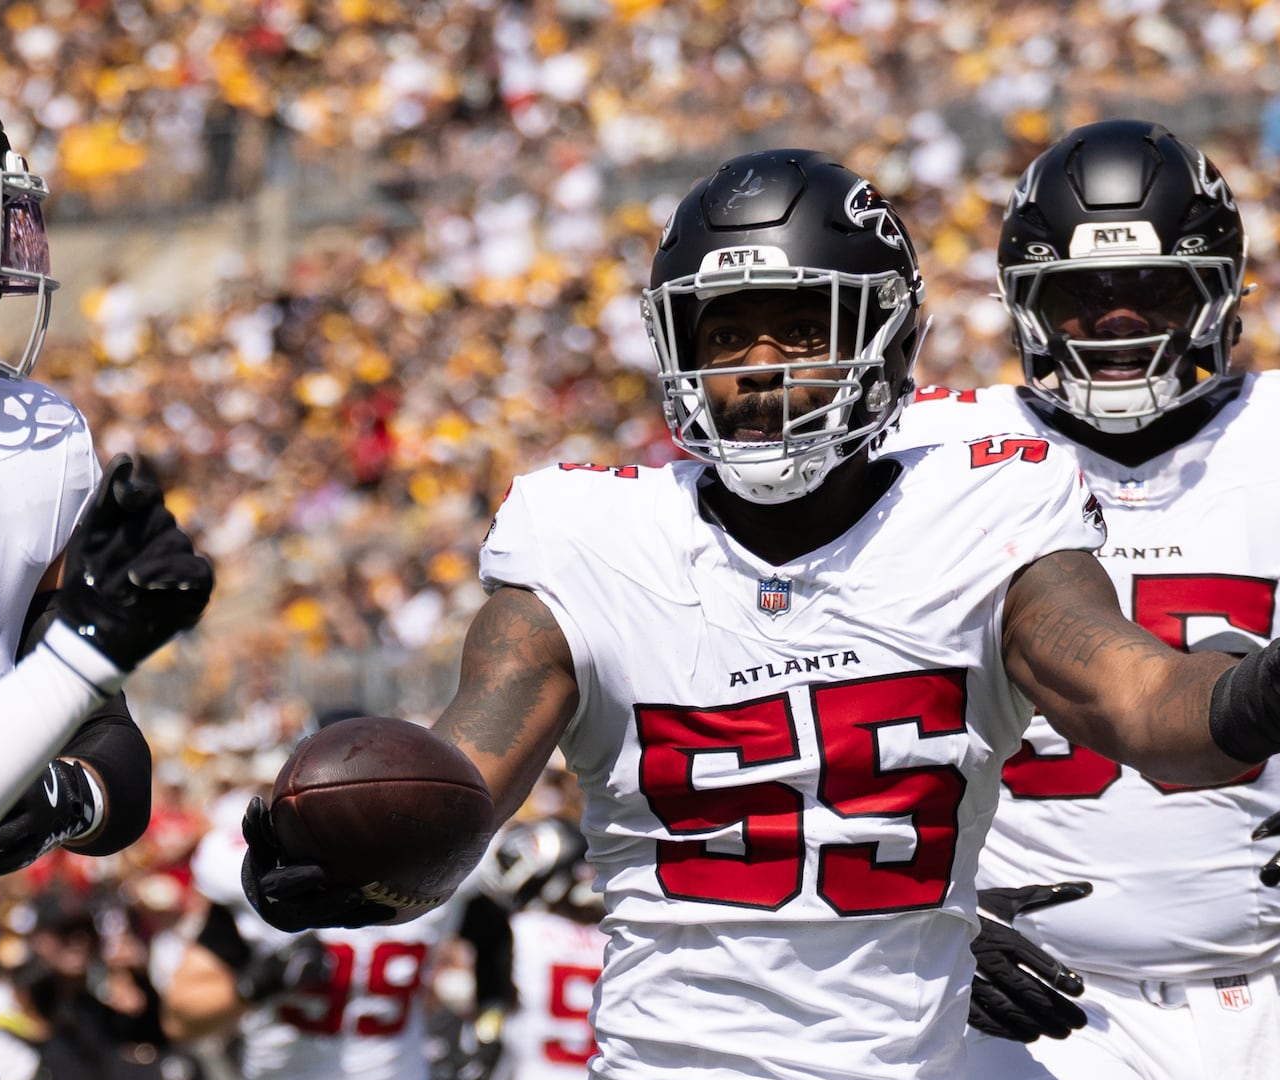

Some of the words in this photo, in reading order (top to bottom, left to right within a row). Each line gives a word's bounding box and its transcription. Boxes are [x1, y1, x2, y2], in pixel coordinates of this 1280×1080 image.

[1093, 227, 1138, 247] ATL
[718, 249, 765, 268] ATL
[1024, 254, 1056, 262] OAKLEY
[1177, 245, 1208, 256] OAKLEY
[969, 438, 1050, 469] 5
[1097, 546, 1183, 559] LANTA
[729, 650, 861, 687] ATLANTA
[634, 667, 968, 917] 55
[278, 942, 427, 1037] 99
[1221, 988, 1249, 1008] NFL
